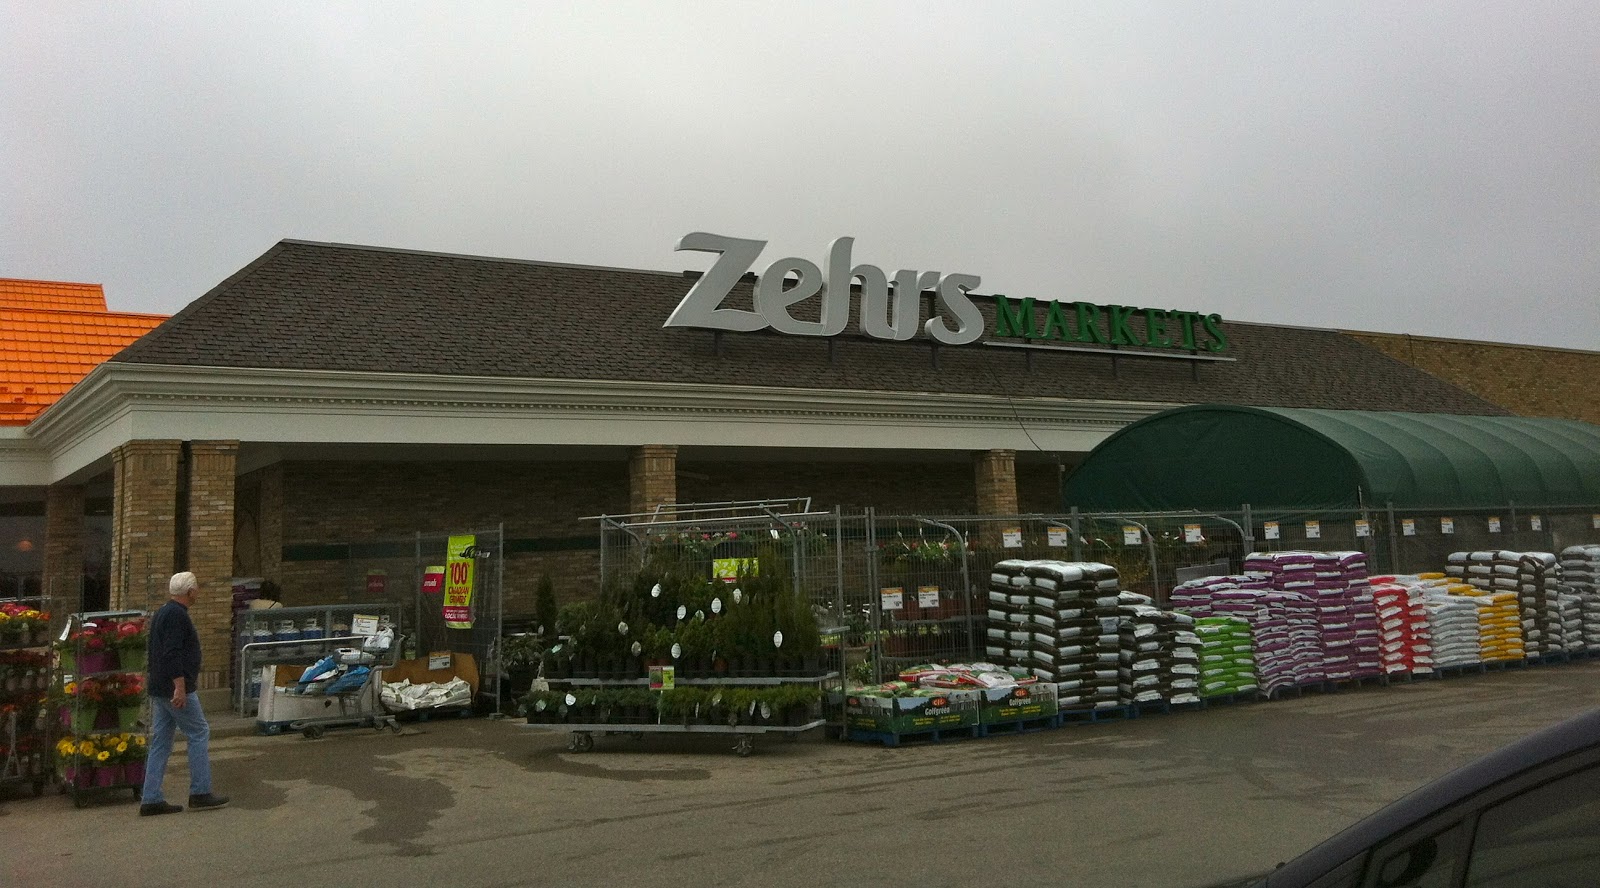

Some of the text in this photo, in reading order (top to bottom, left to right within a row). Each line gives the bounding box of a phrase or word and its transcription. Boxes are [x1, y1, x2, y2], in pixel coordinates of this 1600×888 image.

[663, 231, 1228, 353] Zehrs MARKETS
[924, 706, 950, 716] Golfgreen
